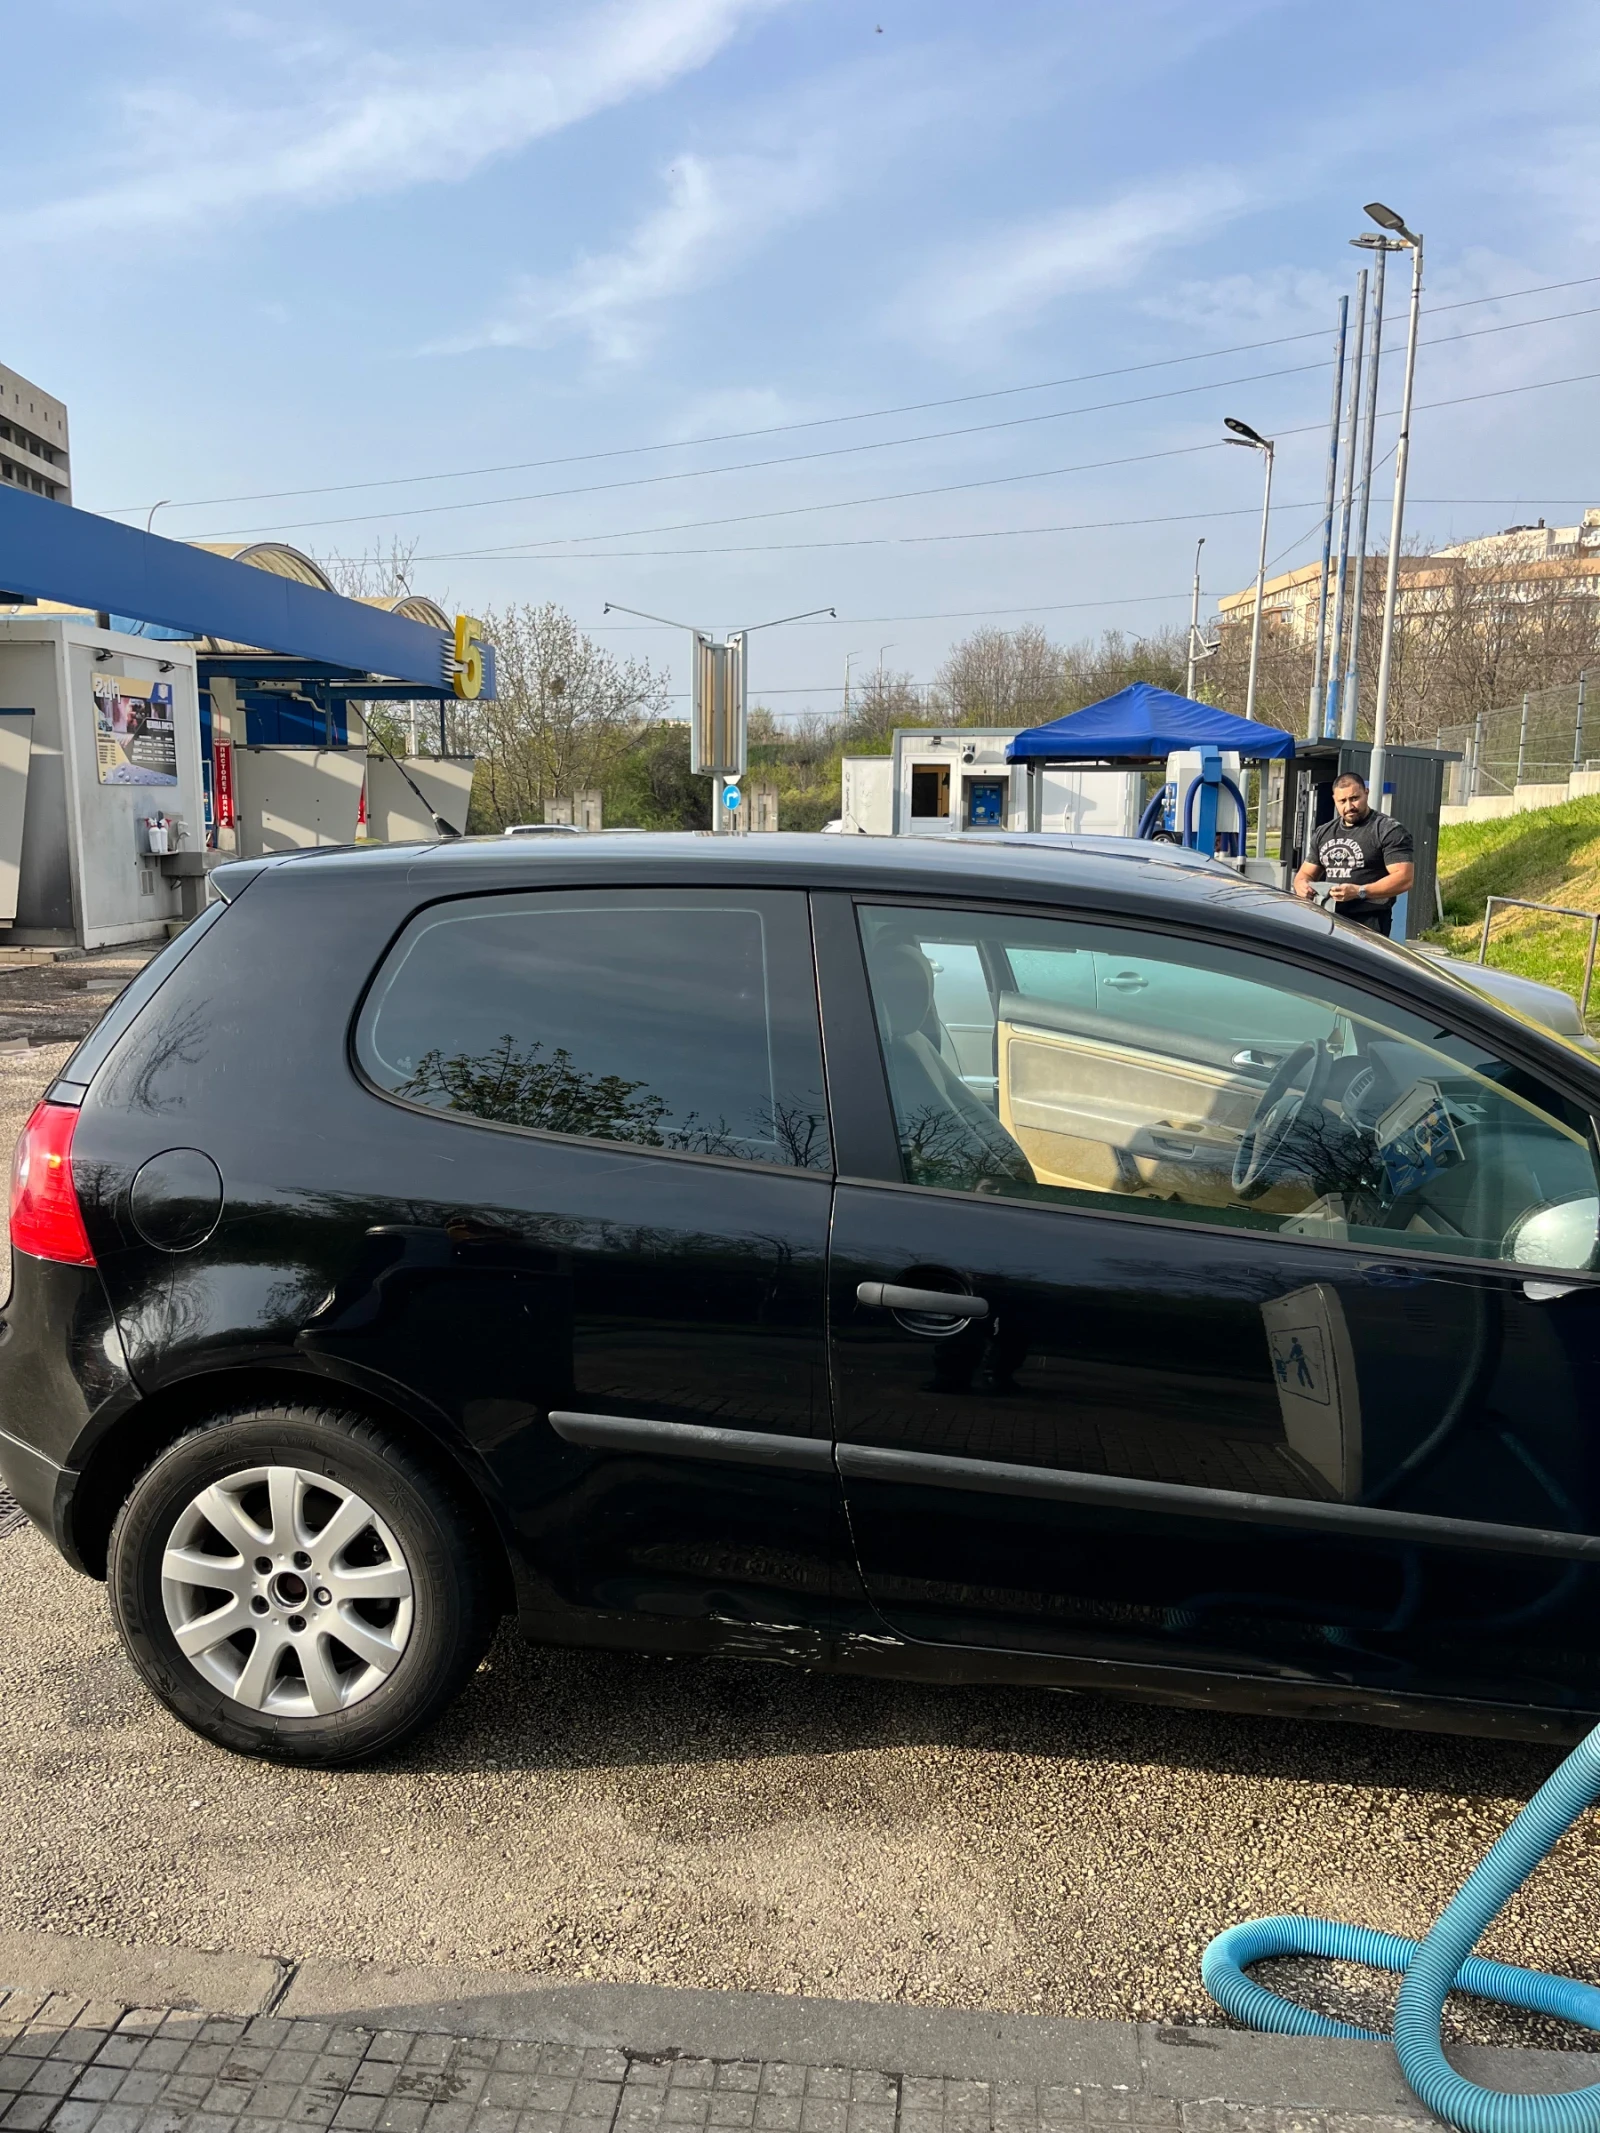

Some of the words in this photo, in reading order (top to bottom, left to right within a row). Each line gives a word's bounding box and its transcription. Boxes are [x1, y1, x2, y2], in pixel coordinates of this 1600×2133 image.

[453, 615, 482, 699] 5
[219, 747, 227, 792] ПИСТОЛЕТ
[1319, 838, 1365, 868] WERHOUSE
[1325, 867, 1353, 878] GYM
